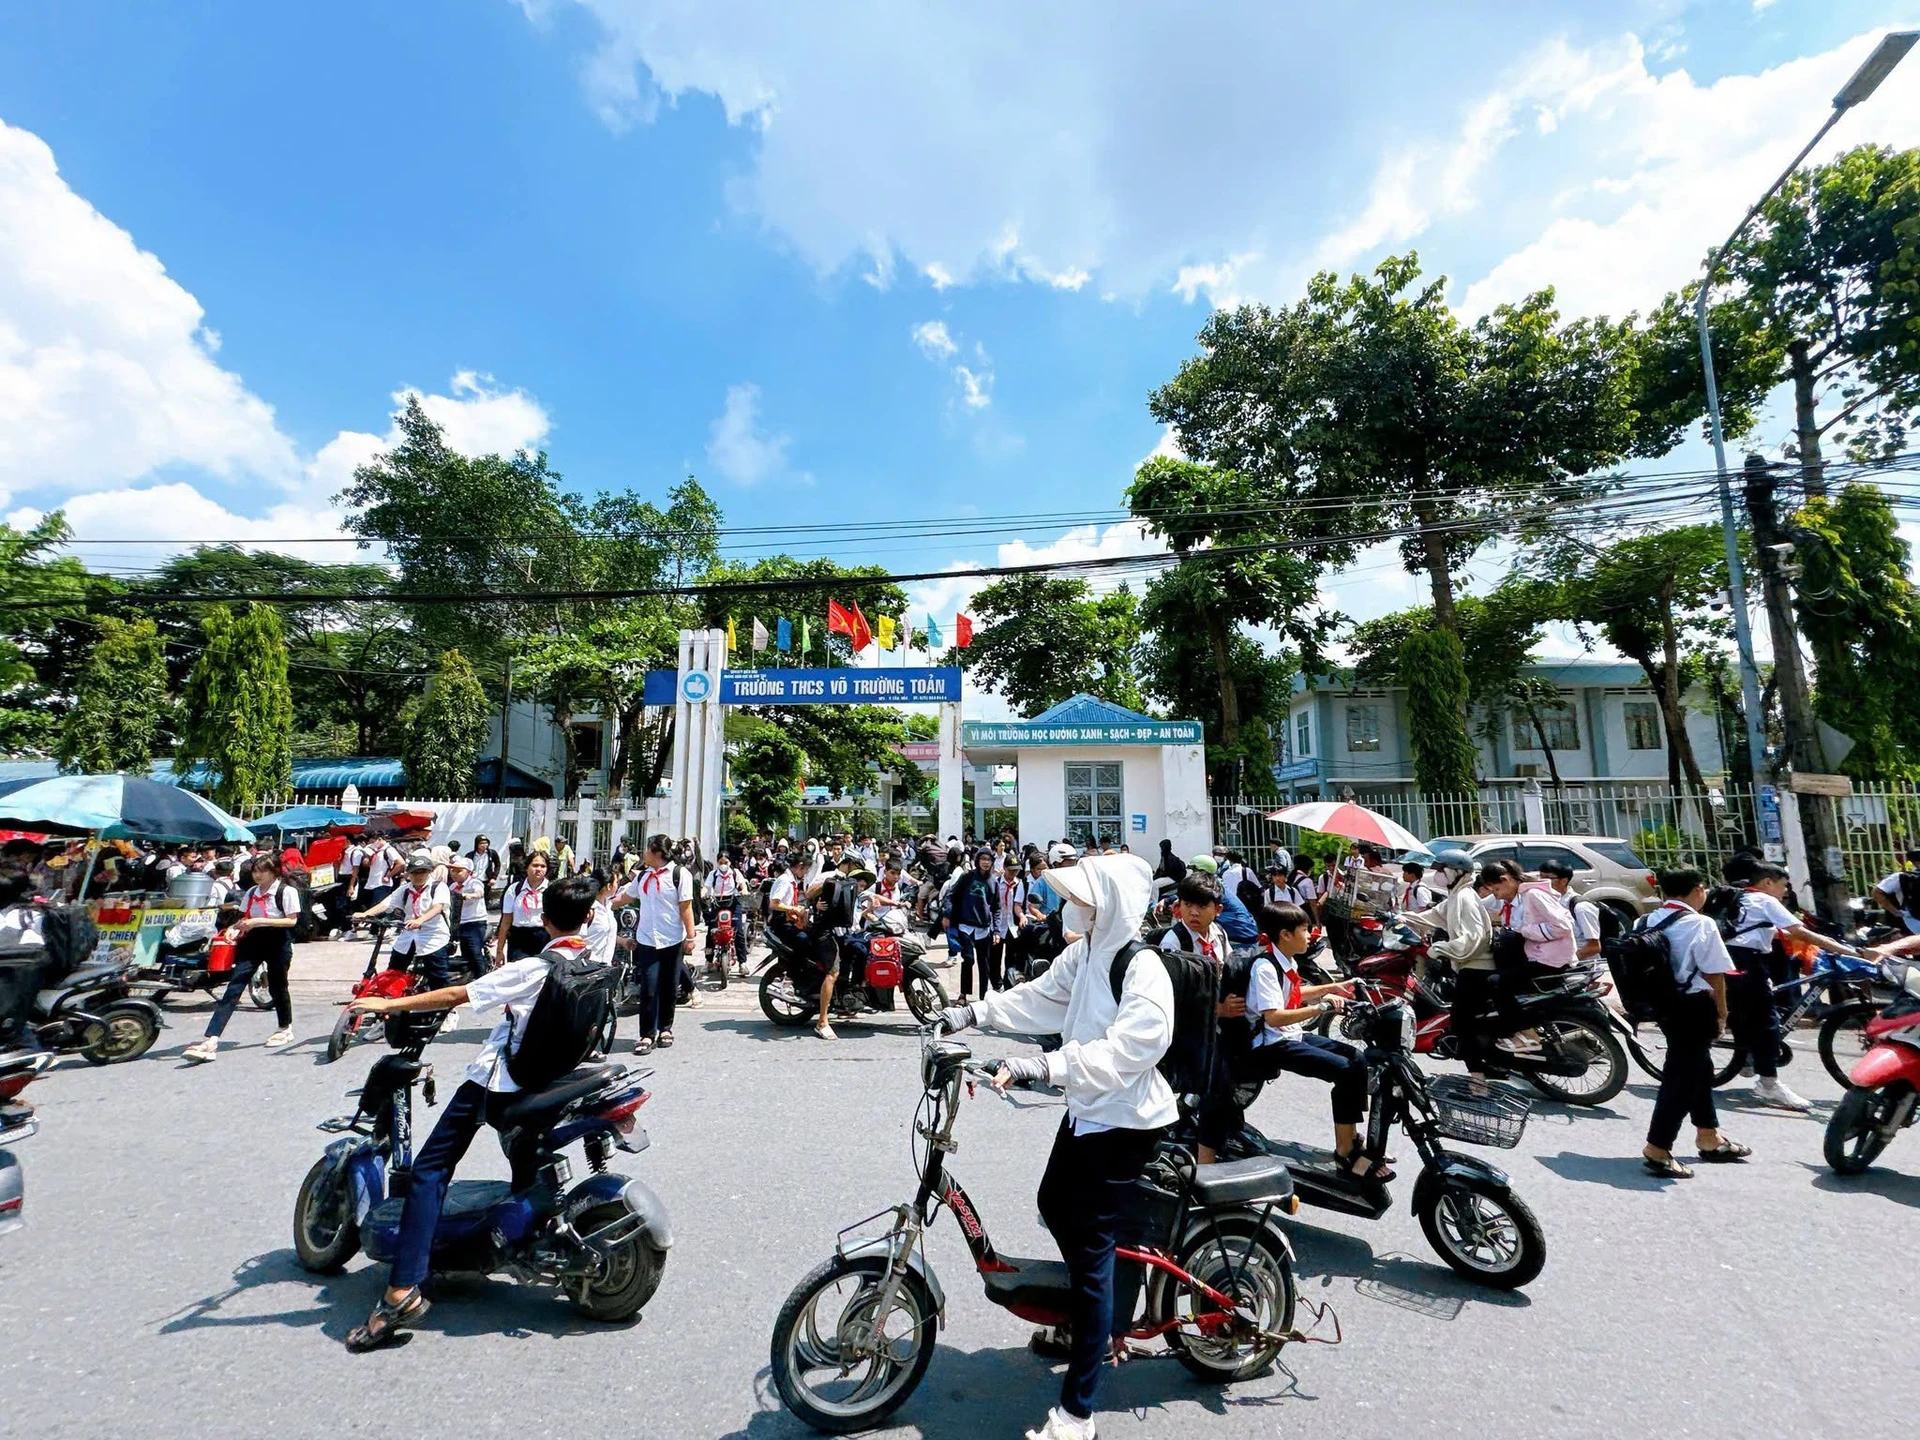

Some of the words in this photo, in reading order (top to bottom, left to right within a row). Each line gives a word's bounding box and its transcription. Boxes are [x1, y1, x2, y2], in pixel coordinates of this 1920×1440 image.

[733, 677, 785, 696] TRƯỜNG
[791, 680, 824, 695] THCS
[830, 676, 848, 695] VÕ
[853, 676, 904, 695] TRƯỜNG
[910, 674, 945, 694] TOẢN
[981, 727, 996, 740] MÔI
[998, 724, 1030, 740] TRƯỜNG
[1032, 729, 1048, 742] HỌC
[1080, 728, 1103, 740] XANH
[1110, 728, 1130, 742] SẠCH
[1136, 728, 1153, 741] ĐẸP
[1160, 727, 1171, 739] AN
[1173, 725, 1195, 739] TOÀN
[950, 1190, 984, 1238] YASUKI
